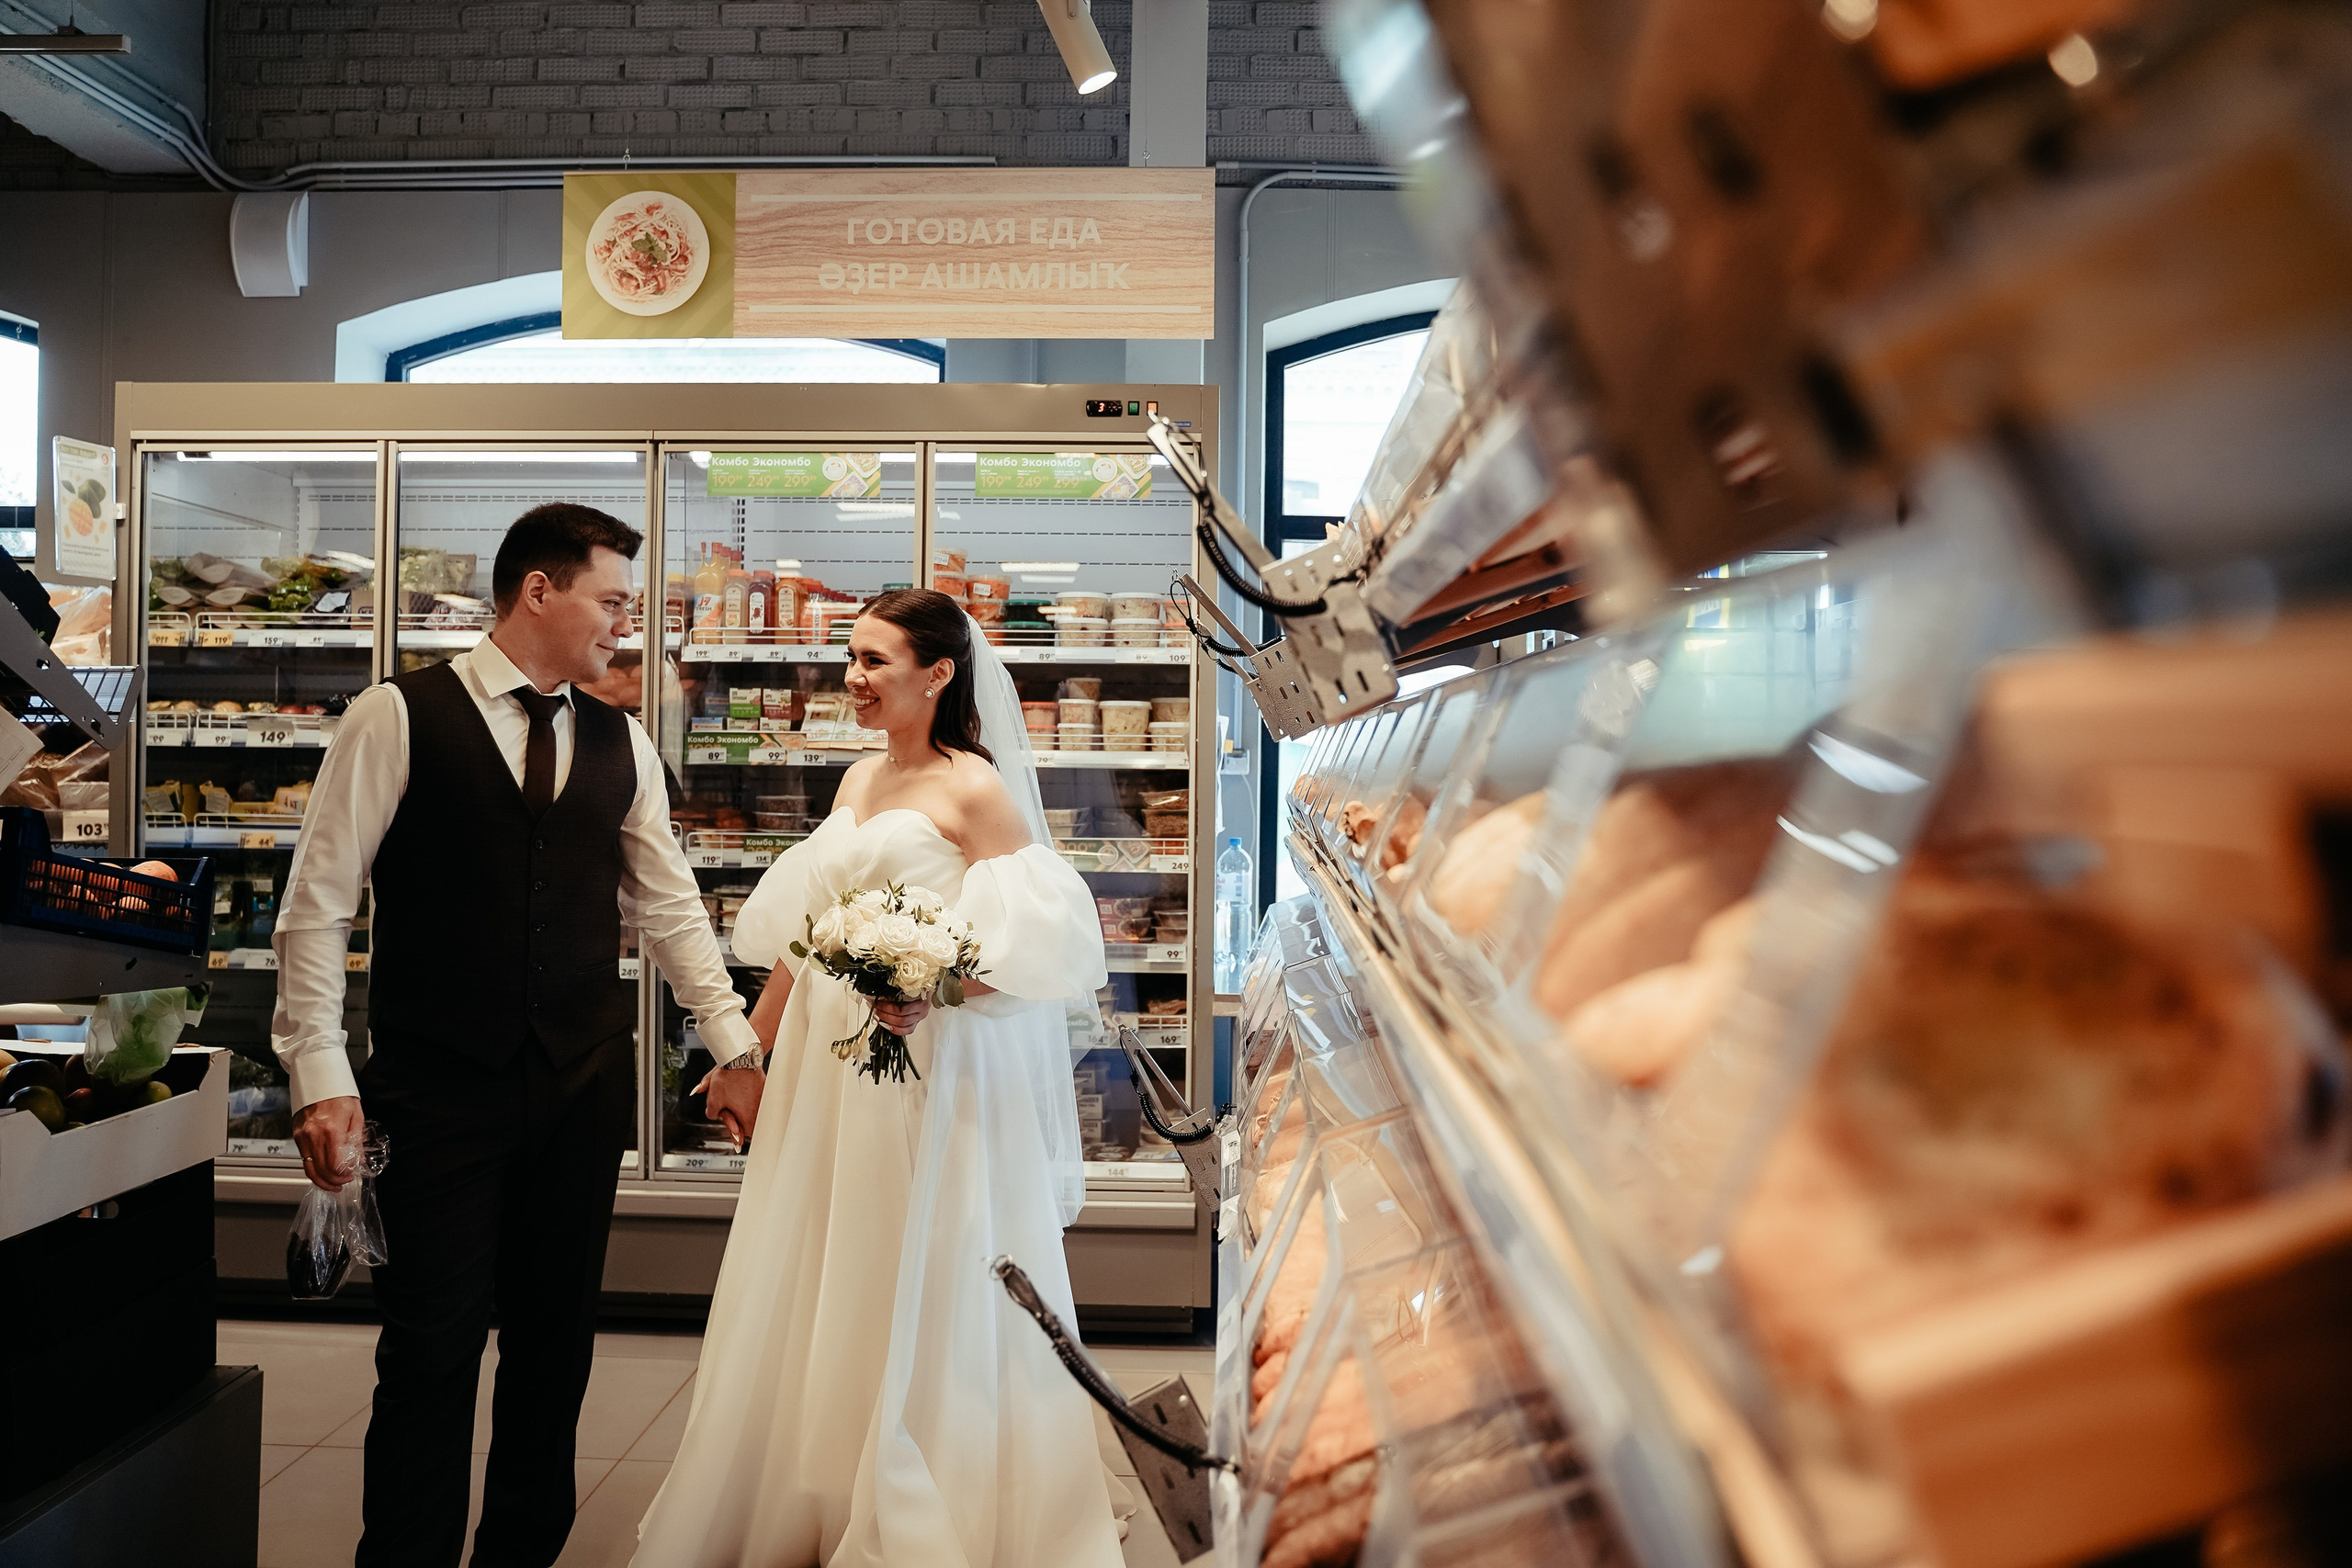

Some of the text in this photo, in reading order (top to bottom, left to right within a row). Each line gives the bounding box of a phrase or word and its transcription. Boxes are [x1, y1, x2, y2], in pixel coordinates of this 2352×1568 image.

[847, 217, 1102, 249] ГОТОВАЯ ЕДА
[1098, 402, 1105, 412] 3
[712, 457, 811, 467] Комбо Экономбо
[979, 457, 1081, 468] Комбо Экономбо
[260, 731, 286, 744] 149
[687, 736, 759, 744] Комбо Экономбо
[804, 754, 820, 762] 139
[76, 823, 103, 837] 103
[1171, 862, 1189, 870] 249
[1167, 950, 1180, 958] 99
[1160, 1035, 1177, 1044] 169
